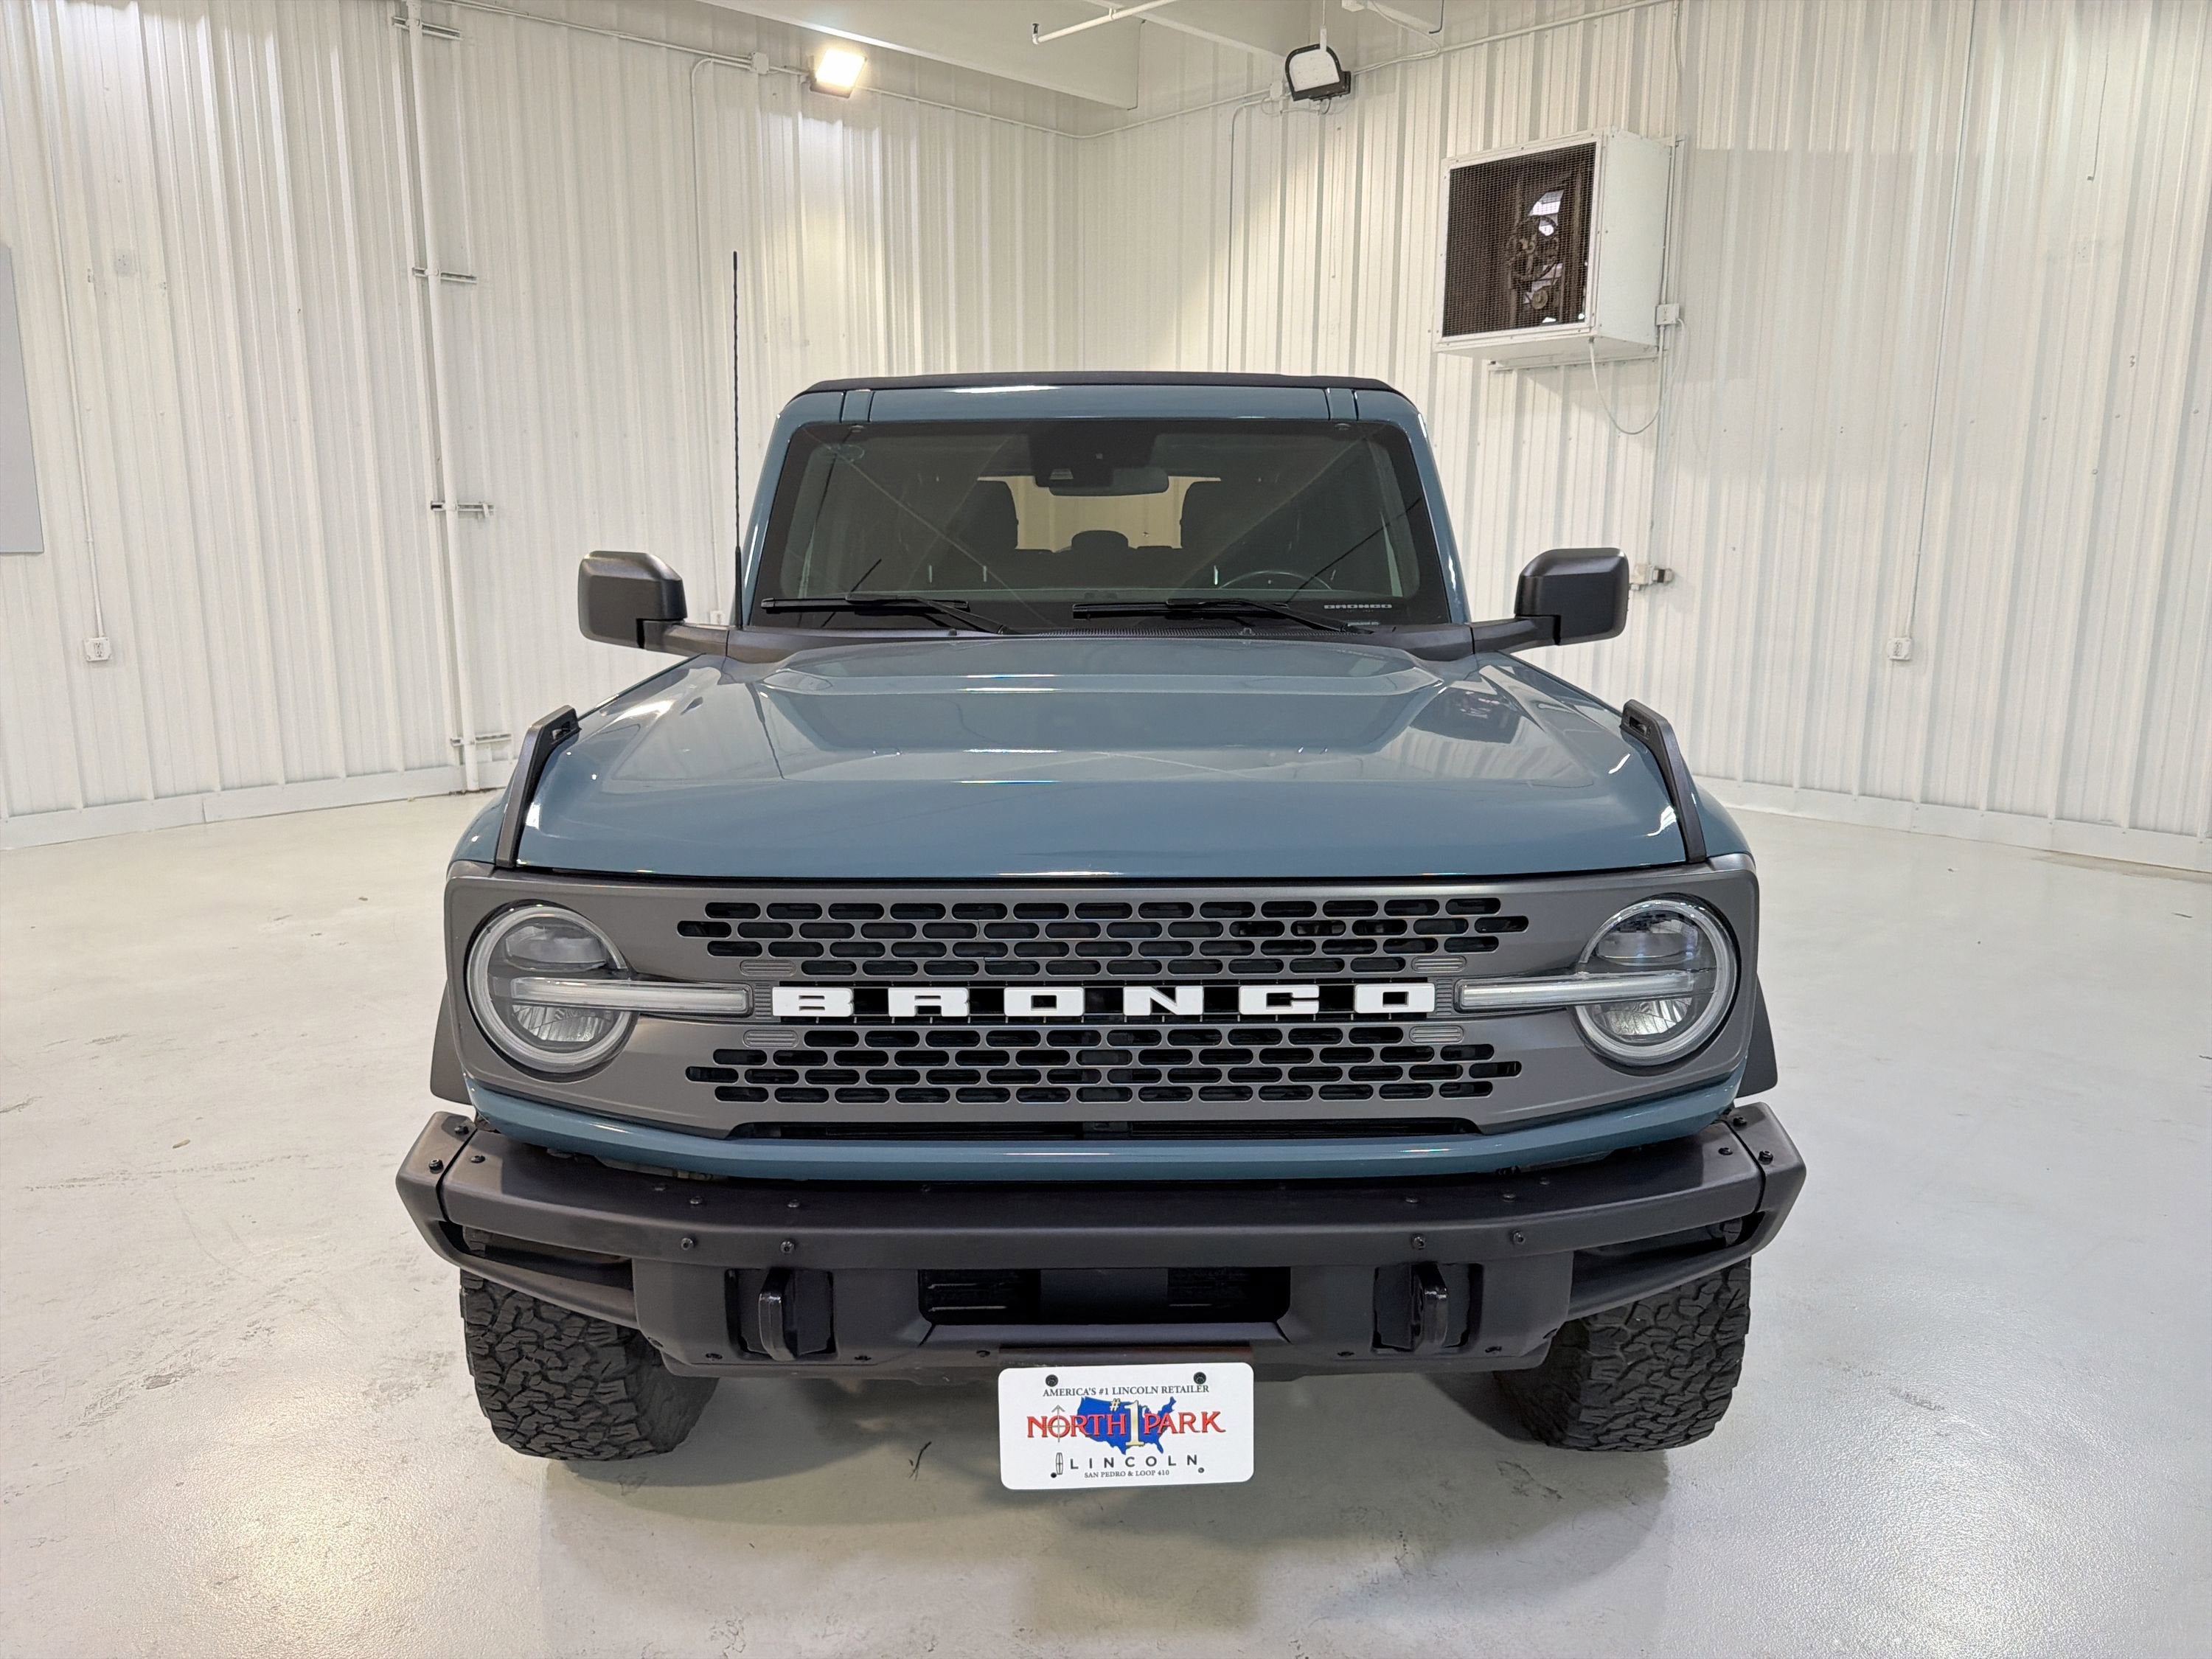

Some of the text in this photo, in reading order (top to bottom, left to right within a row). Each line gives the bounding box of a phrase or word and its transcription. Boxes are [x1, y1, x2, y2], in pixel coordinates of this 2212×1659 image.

[772, 983, 1436, 1018] BRONCO
[1043, 1384, 1210, 1397] AMERICA'S #1 LINCOLN RETAILER
[1026, 1411, 1226, 1438] NORTH PARK
[1070, 1454, 1197, 1470] LINCOLN
